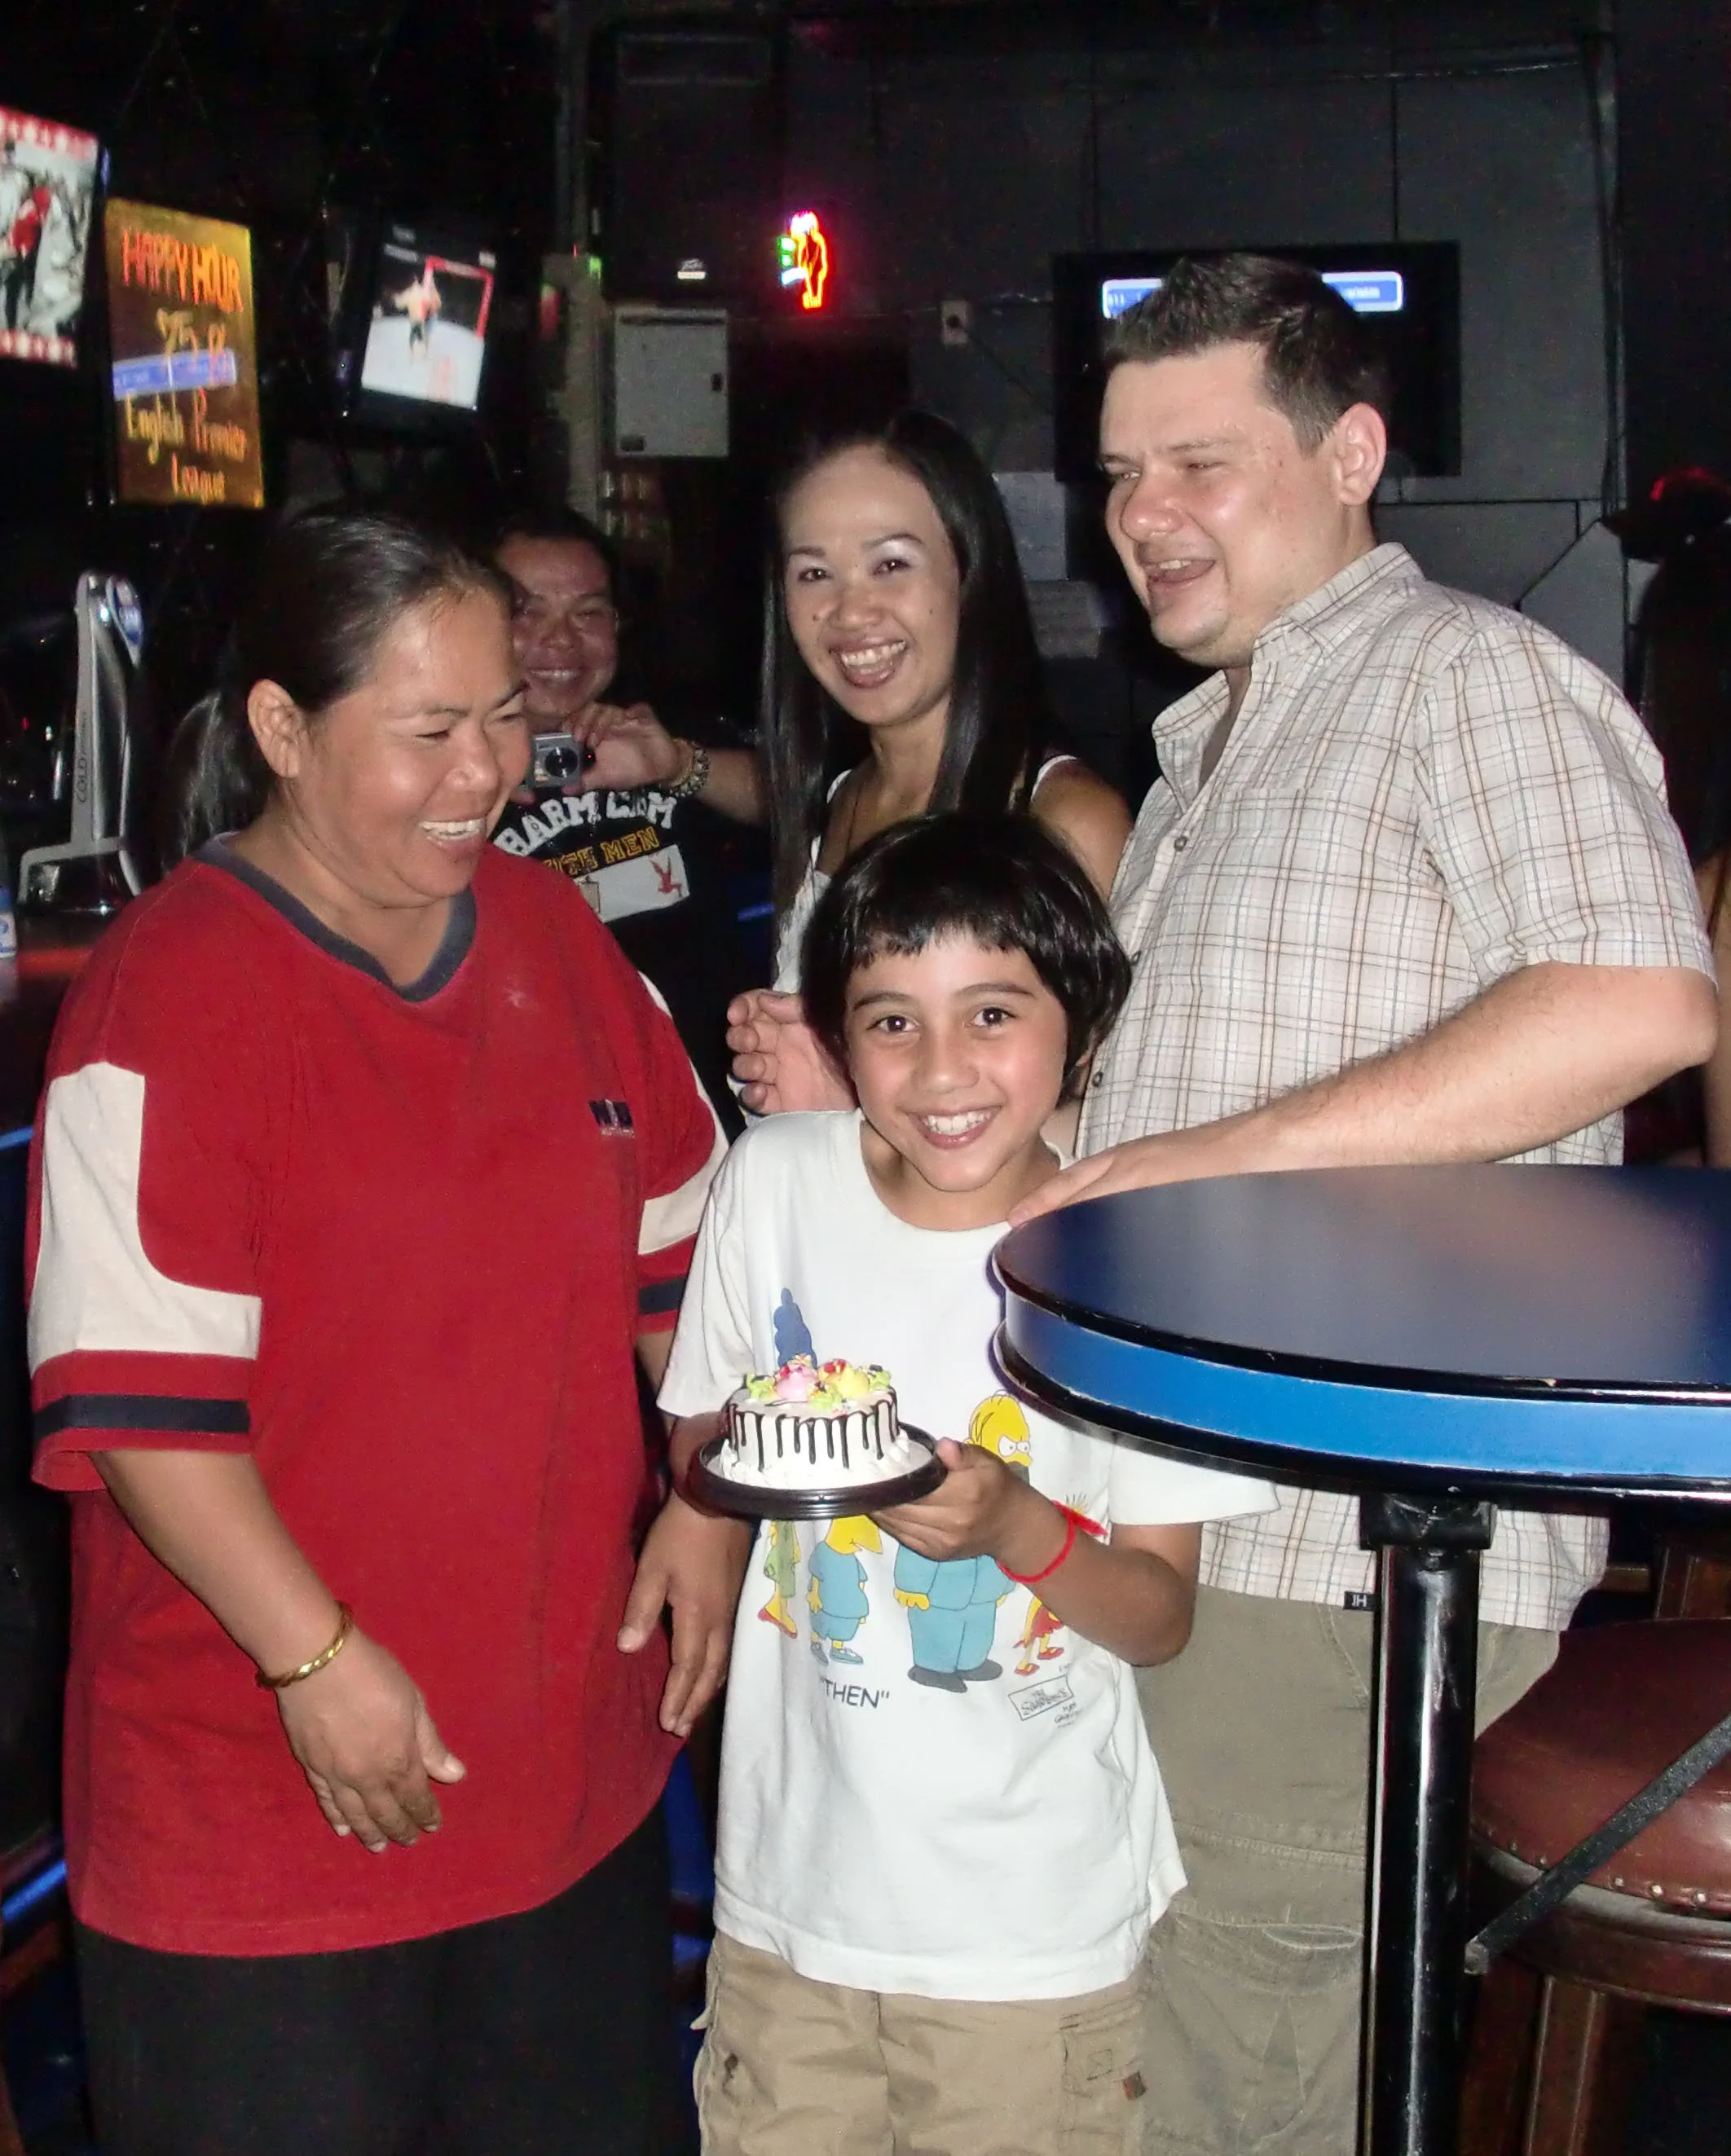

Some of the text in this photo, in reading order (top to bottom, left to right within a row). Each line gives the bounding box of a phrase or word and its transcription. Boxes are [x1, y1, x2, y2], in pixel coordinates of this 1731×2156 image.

[123, 228, 244, 313] HAPPY HOUR
[600, 825, 660, 864] MEN
